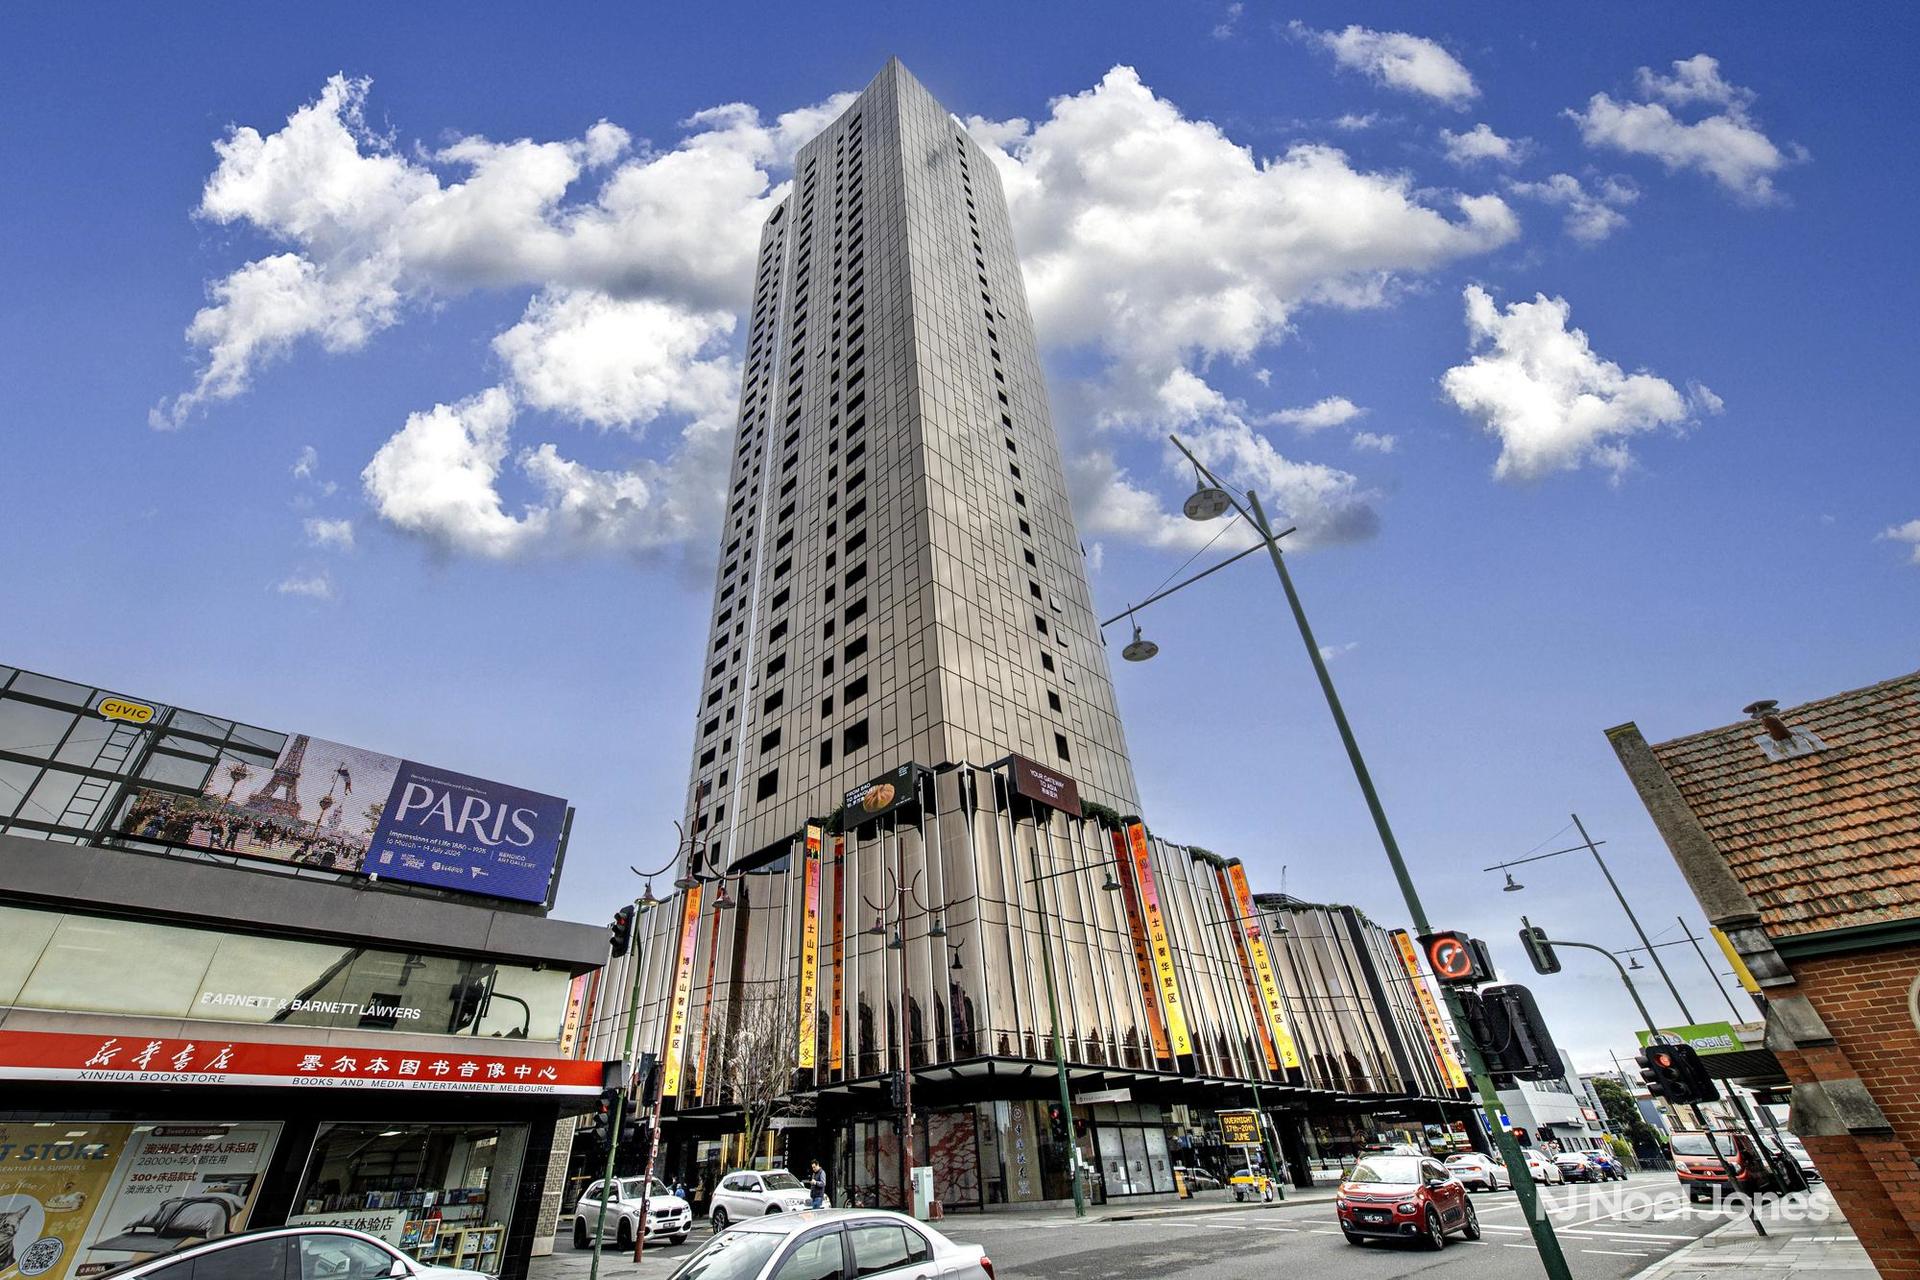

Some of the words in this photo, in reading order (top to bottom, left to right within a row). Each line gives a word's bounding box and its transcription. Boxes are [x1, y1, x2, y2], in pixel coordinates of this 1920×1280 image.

[105, 703, 148, 719] CIVIC
[1029, 768, 1044, 779] YOUR
[395, 782, 538, 846] PARIS
[389, 830, 429, 844] Impressions
[395, 839, 417, 848] March
[201, 991, 273, 1009] BARNETT
[277, 999, 288, 1009] &
[291, 999, 360, 1015] BARNETT
[358, 1004, 422, 1020] LAWYERS
[297, 1054, 559, 1081] 墨尔本图书音像中心
[77, 1070, 134, 1082] XINHUA
[139, 1072, 227, 1084] BOOKSTORE
[292, 1076, 334, 1087] BOOKS
[341, 1078, 364, 1088] AND
[371, 1080, 406, 1089] MEDIA
[412, 1081, 496, 1092] ENTERTAINMENT
[499, 1084, 556, 1093] MELBOURNE
[1223, 1116, 1253, 1125] OVERNIGHT
[1234, 1132, 1251, 1141] JUNE
[19, 1143, 110, 1162] STORE
